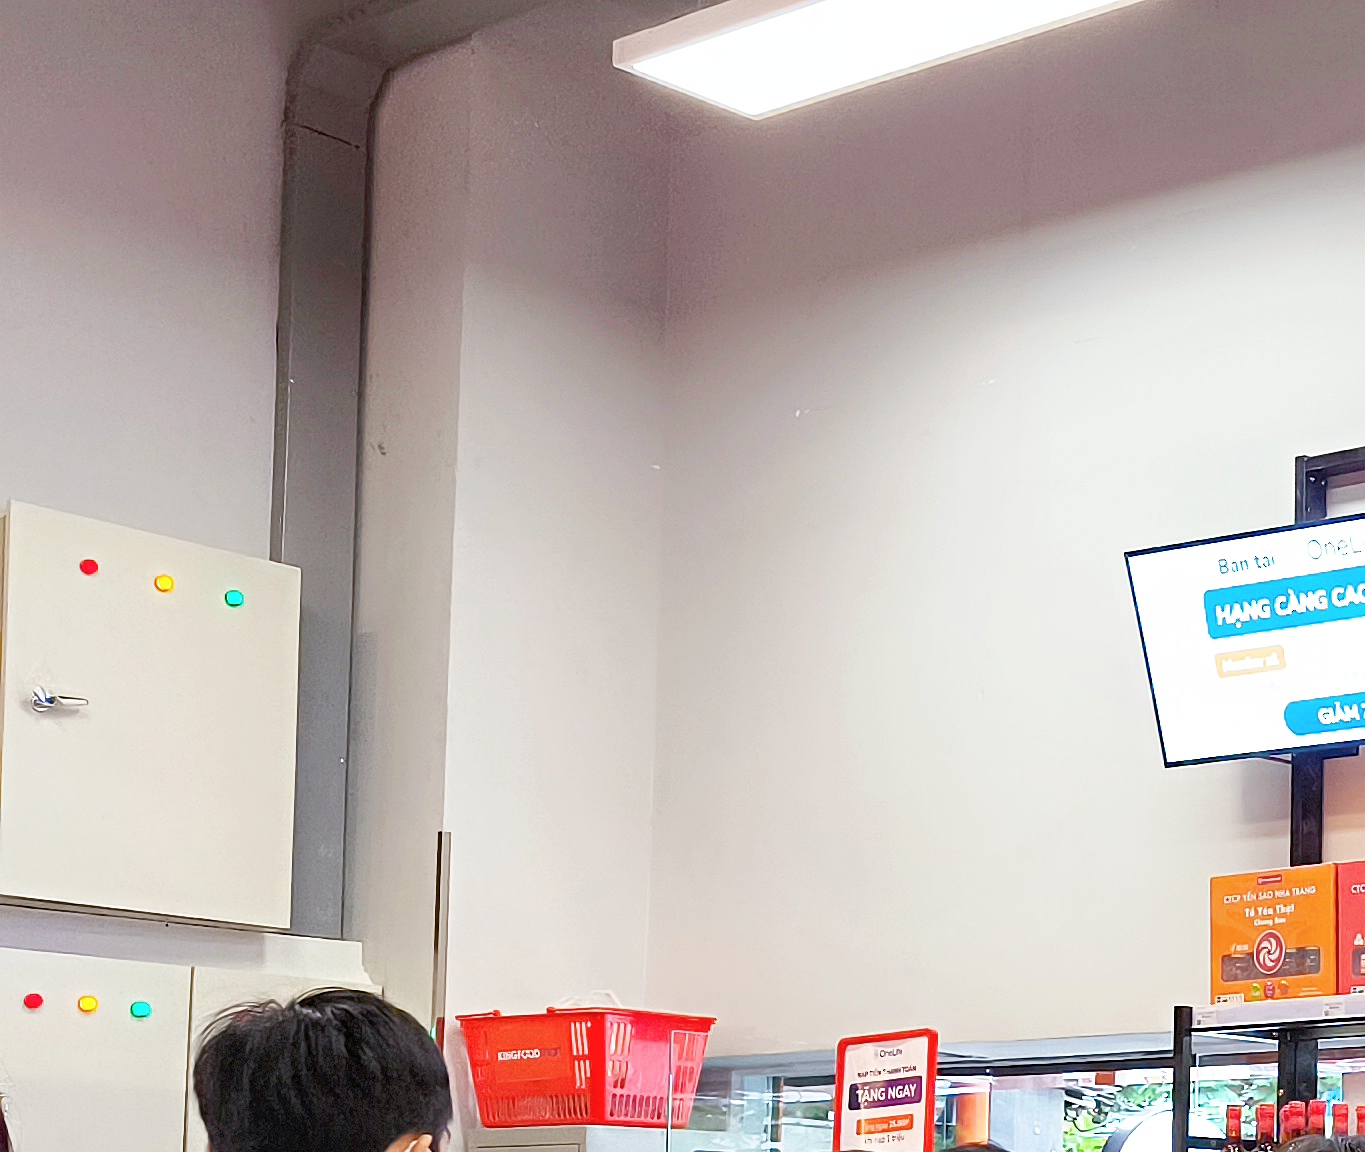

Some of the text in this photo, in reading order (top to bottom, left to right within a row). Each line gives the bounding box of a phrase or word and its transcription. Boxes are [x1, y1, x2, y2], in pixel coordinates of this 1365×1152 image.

[1215, 598, 1271, 629] HẠNG
[1274, 588, 1328, 617] CÀNG
[888, 1083, 917, 1099] NGAY
